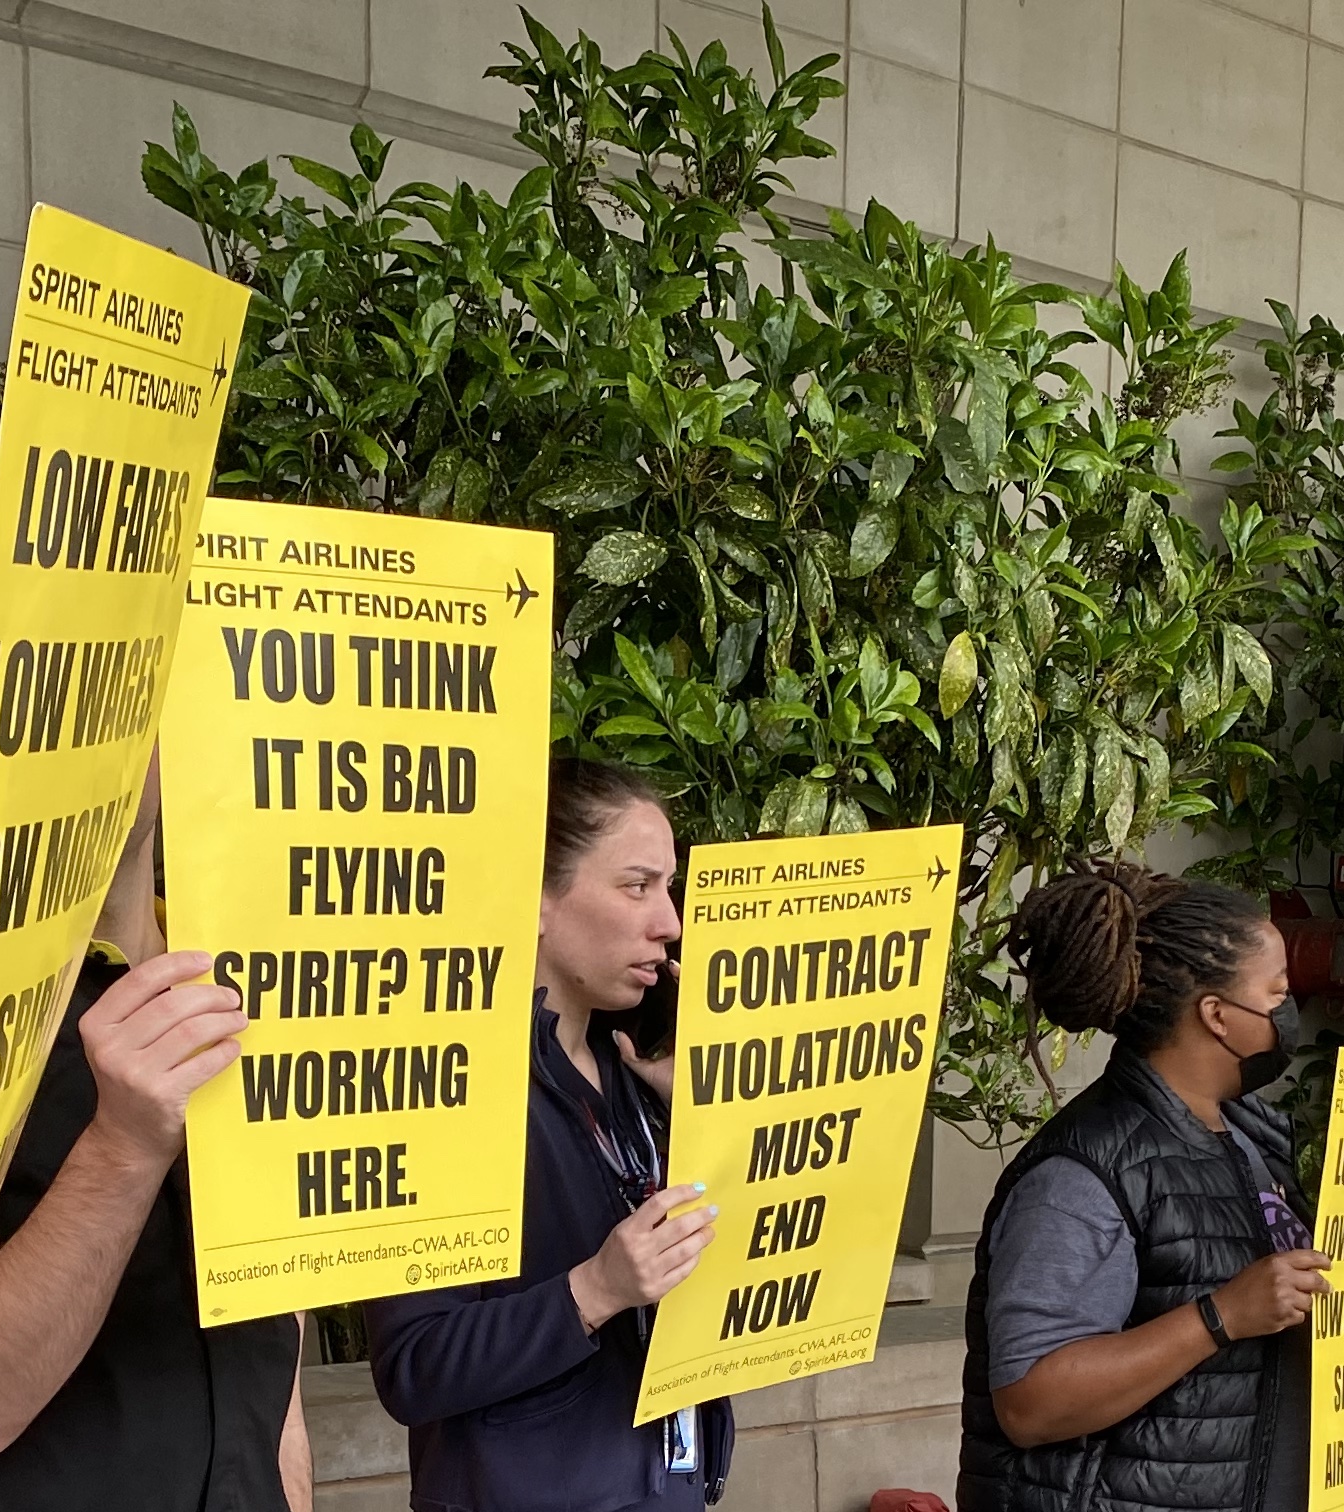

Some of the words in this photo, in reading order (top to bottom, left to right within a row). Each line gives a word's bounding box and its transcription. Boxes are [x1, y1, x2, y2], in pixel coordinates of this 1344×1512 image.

[29, 263, 100, 316] SPIRIT
[103, 288, 183, 345] AIRLINES
[17, 341, 98, 394] FLIGHT
[101, 365, 202, 419] ATTENDANTS
[13, 446, 113, 571] LOW
[105, 459, 190, 582] FARES,
[196, 534, 268, 562] IRIT
[280, 539, 416, 574] AIRLINES
[186, 581, 282, 610] LIGHT
[293, 588, 487, 626] ATTENDANTS
[221, 627, 335, 704] YOU
[350, 636, 497, 714] THINK
[252, 738, 303, 810] IT
[318, 740, 367, 812] IS
[382, 743, 476, 814] BAD
[289, 846, 445, 916] FLYING
[694, 900, 772, 924] FLIGHT
[778, 887, 912, 917] ATTENDANTS
[697, 866, 765, 889] SPIRIT
[772, 858, 865, 883] AIRLINES
[213, 948, 408, 1020] SPIRIT?
[420, 946, 504, 1013] TRY
[707, 928, 931, 1013] CONTRACT
[241, 1043, 468, 1123] WORKING
[689, 1013, 926, 1106] VIOLATIONS
[297, 1143, 417, 1219] HERE.
[746, 1108, 862, 1184] MUST
[206, 1262, 279, 1286] Association
[282, 1255, 297, 1274] of
[300, 1252, 334, 1274] Flight
[448, 1227, 509, 1250] AFL-CIO
[747, 1195, 826, 1261] END
[425, 1256, 509, 1280] SpiritAFA.org
[719, 1269, 821, 1341] NOW
[1313, 1290, 1344, 1340] LOW
[646, 1372, 698, 1398] Association
[701, 1365, 712, 1379] of
[714, 1360, 739, 1377] Flight
